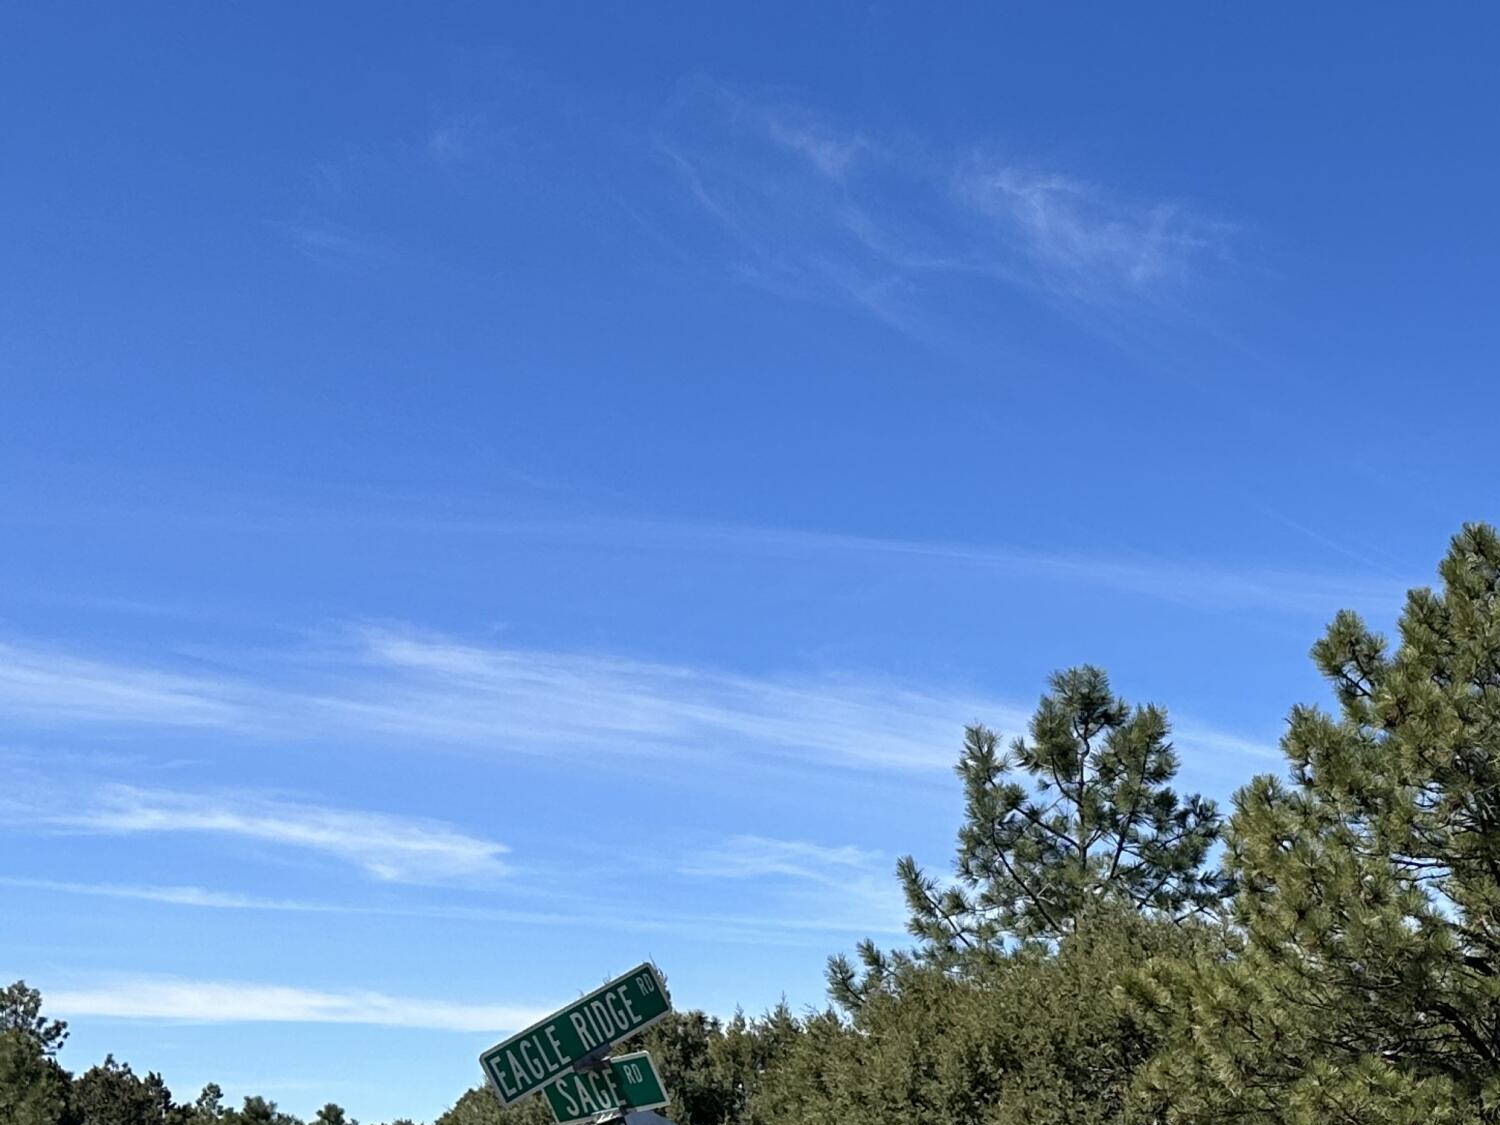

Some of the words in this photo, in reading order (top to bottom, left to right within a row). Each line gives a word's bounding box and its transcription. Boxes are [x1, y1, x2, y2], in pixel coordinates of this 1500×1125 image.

[490, 1024, 571, 1098] EAGLE
[570, 985, 642, 1051] RIDGE
[636, 973, 655, 996] RD
[556, 1069, 626, 1116] SAGE
[624, 1065, 643, 1085] RD
